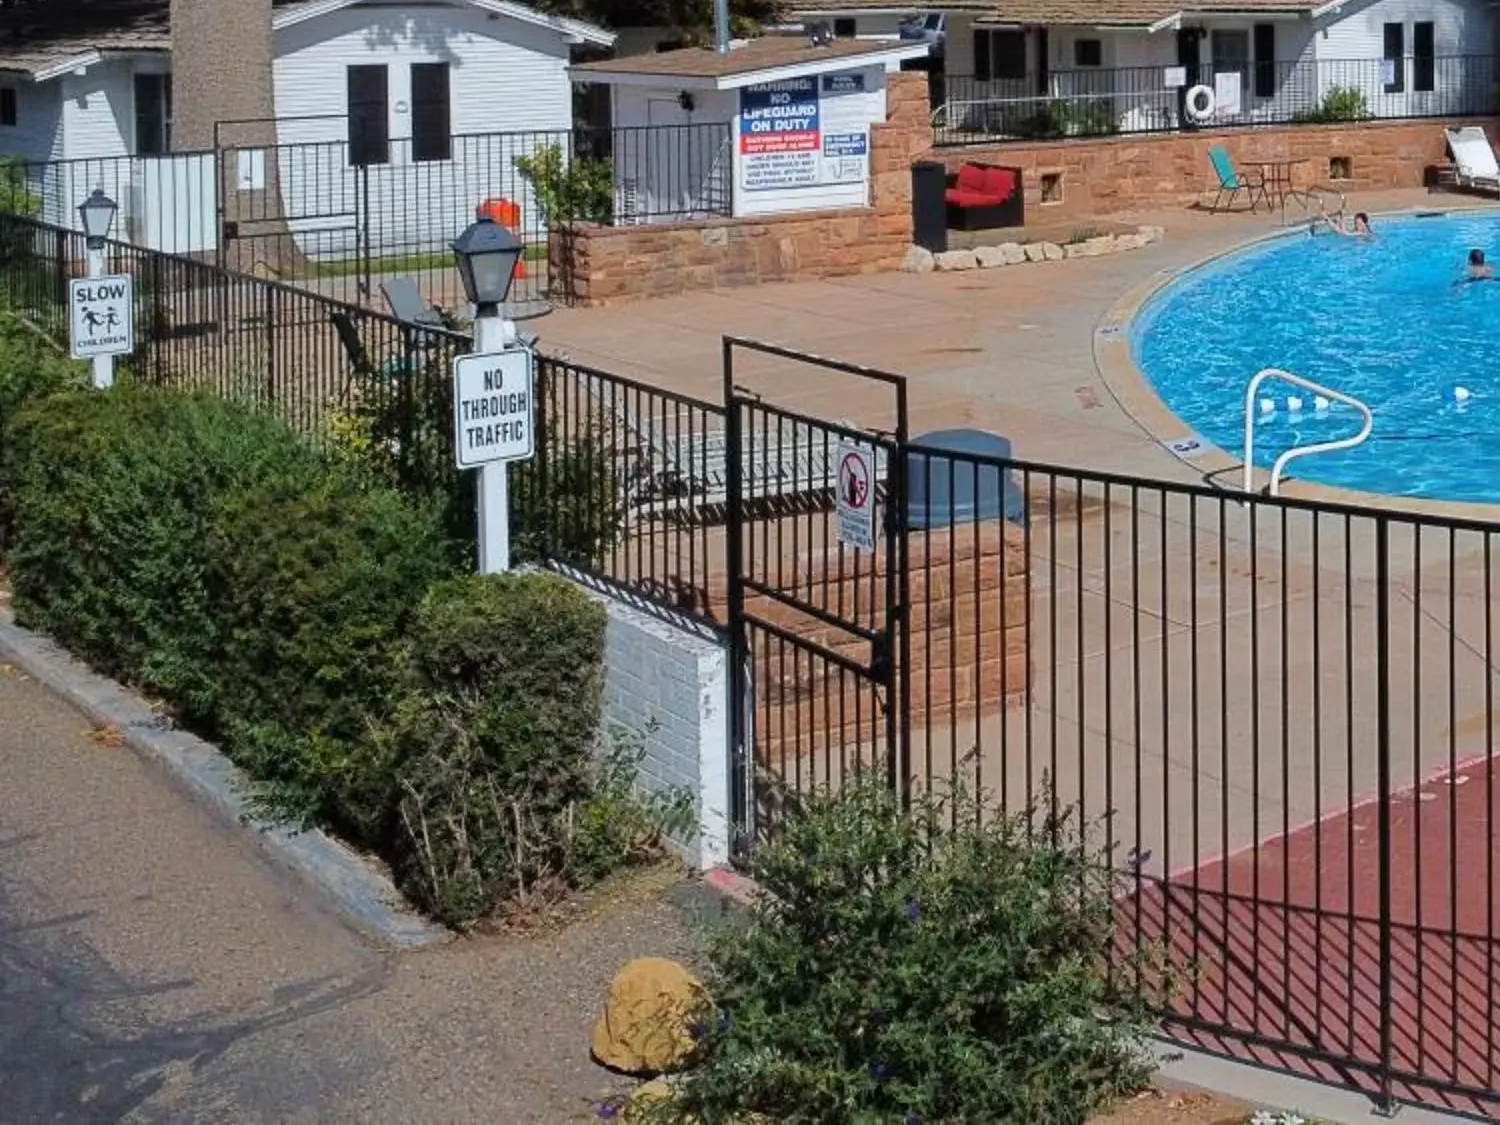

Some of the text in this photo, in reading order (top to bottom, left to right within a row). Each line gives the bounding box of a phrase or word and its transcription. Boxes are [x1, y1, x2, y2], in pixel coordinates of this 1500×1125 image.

[770, 92, 791, 105] NO
[743, 104, 816, 120] LIFEGUARD
[751, 118, 810, 132] ON DUTY
[77, 284, 125, 303] SLOW
[77, 335, 127, 348] CHILDREN
[483, 369, 503, 392] NO
[462, 391, 527, 421] THROUGH
[467, 420, 524, 449] TRAFFIC
